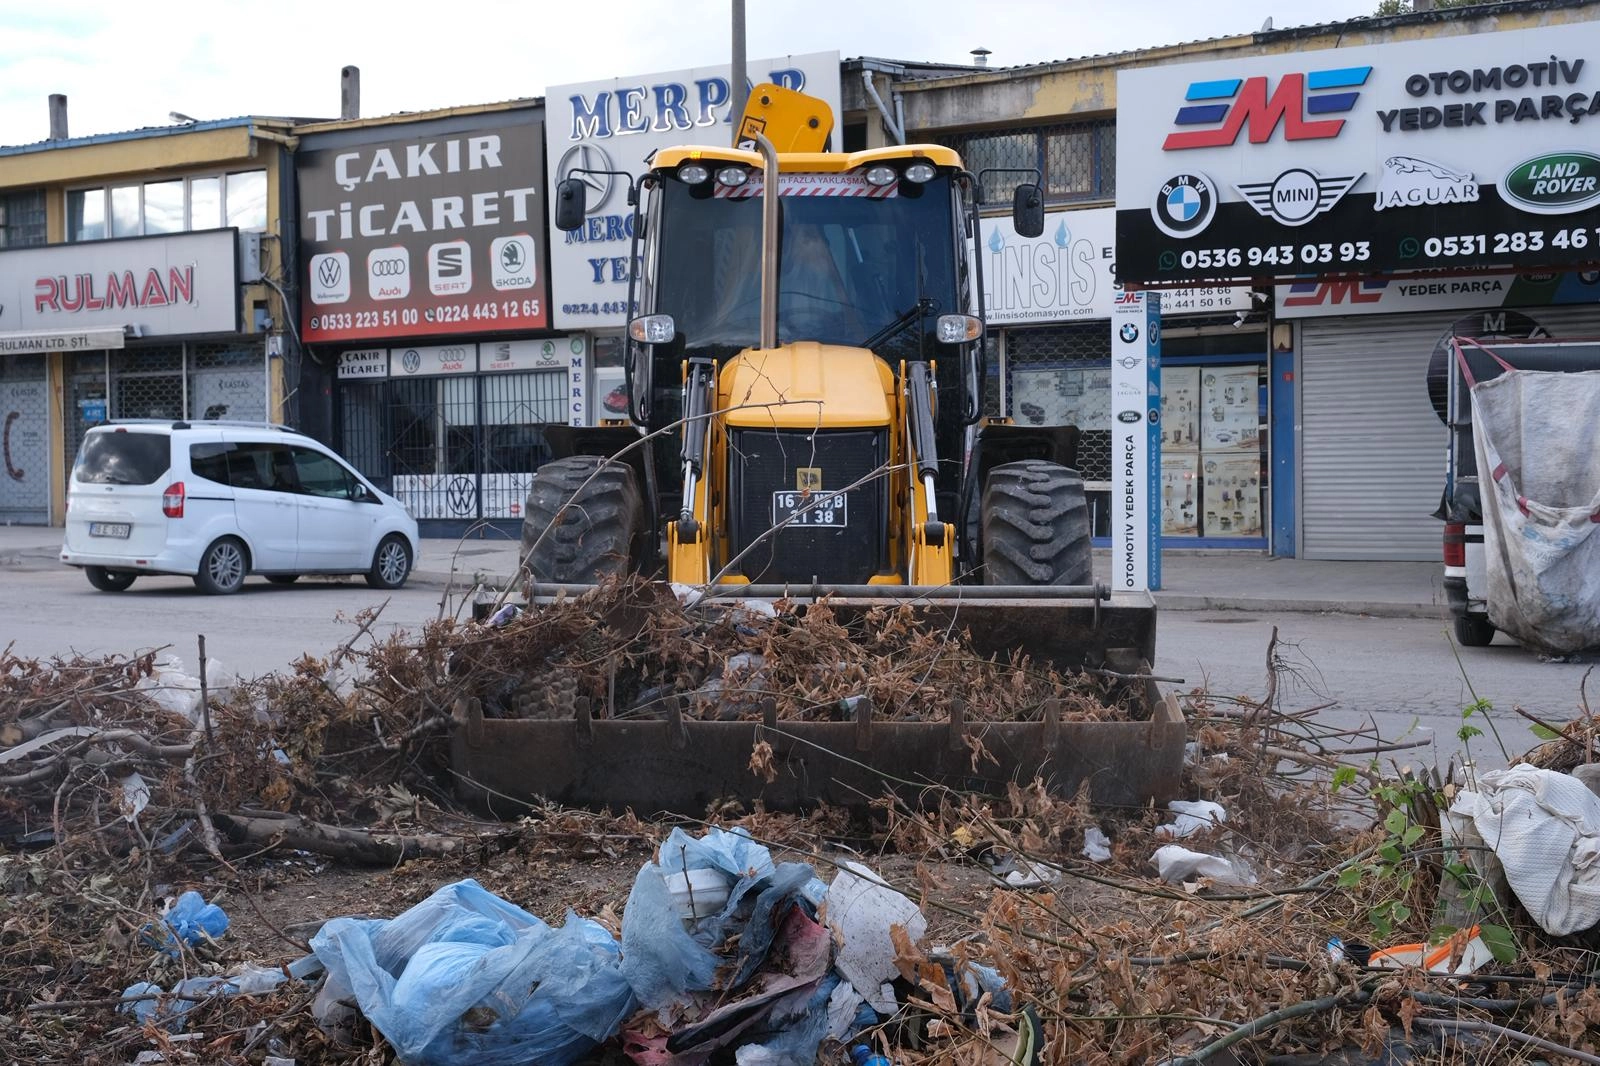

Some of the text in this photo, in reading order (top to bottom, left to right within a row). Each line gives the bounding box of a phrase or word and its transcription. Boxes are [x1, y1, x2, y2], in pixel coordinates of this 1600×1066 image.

[1405, 55, 1585, 97] OTOMOTİV
[1376, 101, 1487, 133] YEDEK
[335, 135, 502, 191] ÇAKIR
[1528, 162, 1580, 180] LAND
[1162, 175, 1207, 195] BMW
[1378, 184, 1475, 205] JAGUAR
[1532, 176, 1596, 195] ROVER
[1277, 188, 1314, 203] MINI
[307, 187, 536, 242] TİCARET
[1424, 234, 1487, 258] 0531
[1493, 231, 1544, 253] 283
[1552, 228, 1588, 249] 46
[1181, 241, 1371, 269] 0536 943 03 93
[34, 264, 196, 313] RULMAN
[379, 287, 402, 296] Audi
[434, 281, 467, 291] SEAT
[1175, 288, 1194, 297] 441
[1200, 287, 1213, 296] 56
[1217, 286, 1231, 294] 66
[1399, 280, 1503, 296] YEDEK PARÇA
[436, 299, 539, 322] 0224 443 12 65
[1175, 300, 1195, 308] 441
[1200, 298, 1213, 307] 50
[1218, 297, 1231, 306] 16
[321, 308, 418, 330] 0533 223 51 00
[46, 337, 67, 348] LTD.
[71, 334, 90, 349] ŞTİ.
[340, 363, 386, 375] TİCARET
[778, 494, 795, 508] 16
[814, 510, 834, 523] 38
[1124, 435, 1136, 587] OTOMOTİV YEDEK PARÇA
